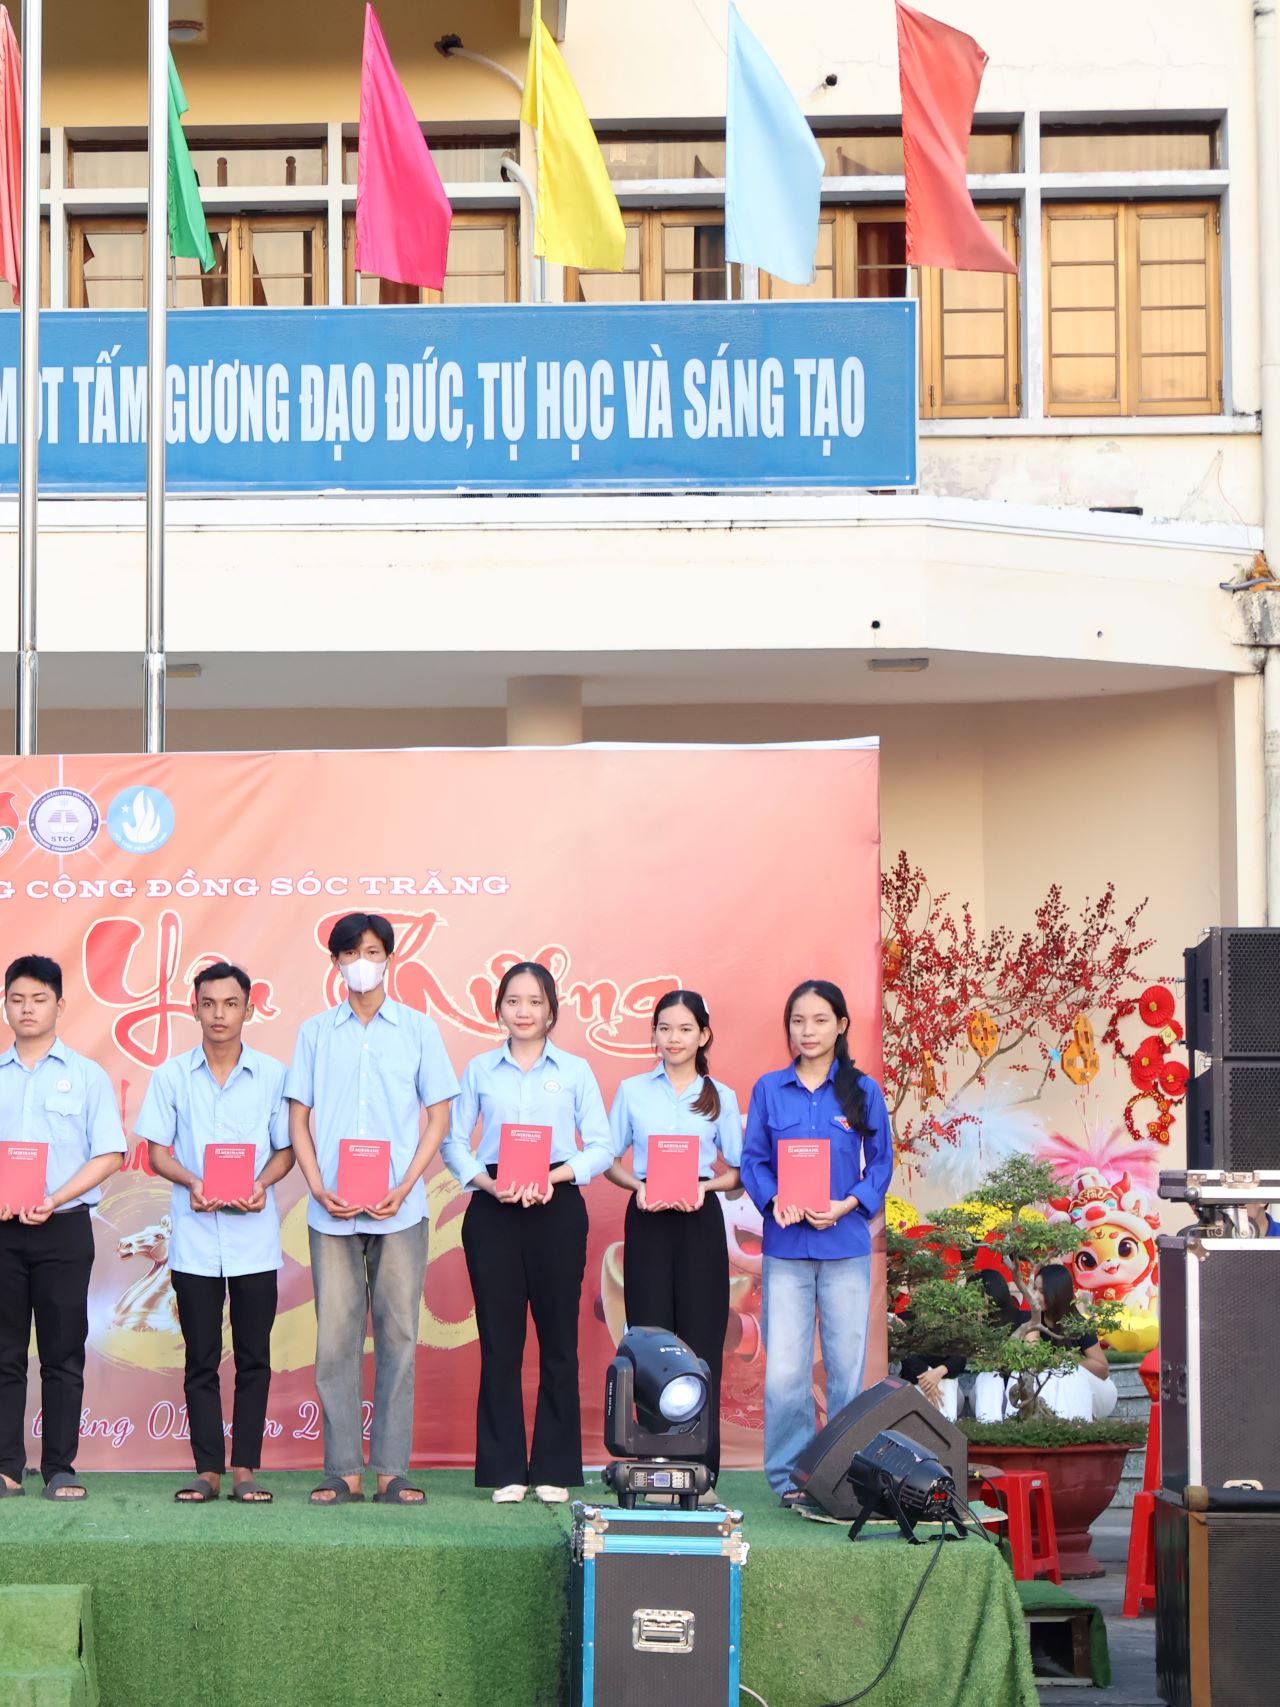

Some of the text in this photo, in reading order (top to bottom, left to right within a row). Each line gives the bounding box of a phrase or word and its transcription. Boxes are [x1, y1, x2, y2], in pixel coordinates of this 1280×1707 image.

[73, 345, 148, 445] TẤM
[165, 359, 291, 445] GƯƠNG
[299, 363, 376, 462] ĐẠO
[385, 346, 474, 449] ĐỨC,
[478, 356, 528, 462] TỰ
[537, 359, 615, 461] HỌC
[623, 344, 674, 439] VÀ
[683, 343, 785, 440] SÁNG
[794, 356, 866, 457] TẠO
[25, 873, 136, 903] CỘNG
[146, 868, 260, 898] ĐỒNG
[269, 870, 349, 897] SÓC
[358, 869, 510, 896] TRĂNG
